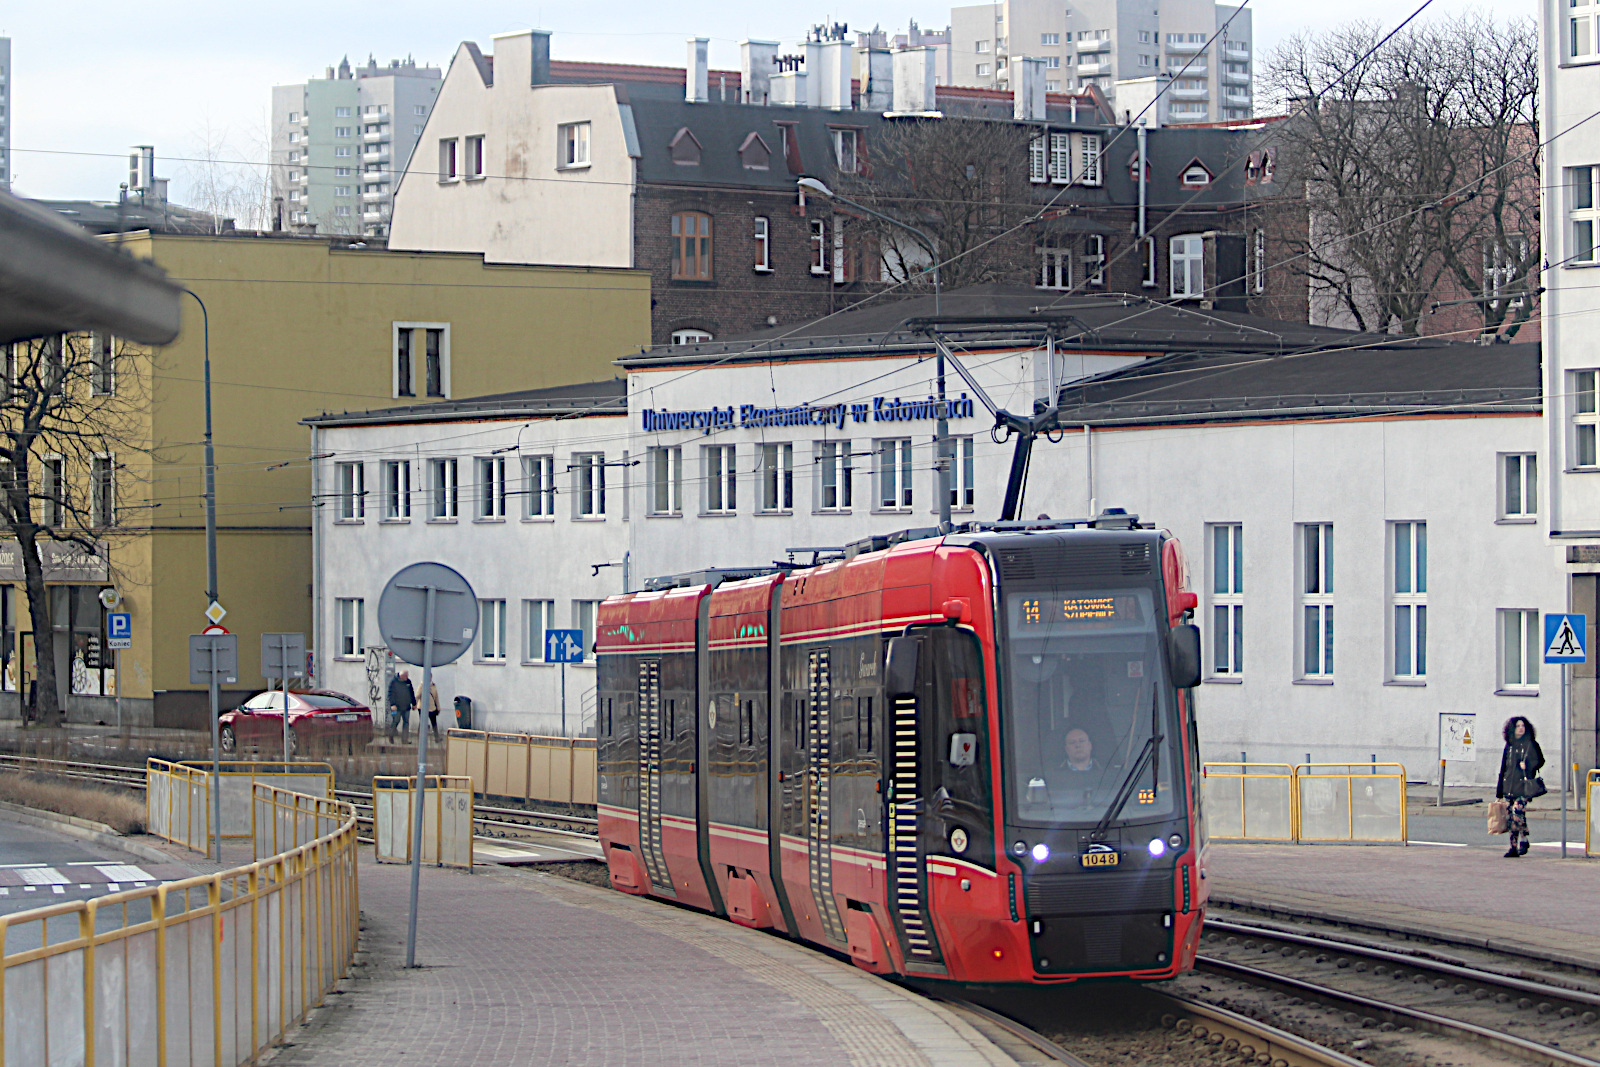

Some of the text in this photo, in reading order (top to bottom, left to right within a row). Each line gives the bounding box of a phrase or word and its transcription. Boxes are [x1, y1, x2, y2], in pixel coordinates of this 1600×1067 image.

[642, 405, 735, 435] Uniwersytet
[739, 402, 848, 430] Ekonomiczny
[850, 402, 869, 424] w
[1022, 600, 1040, 623] 14
[112, 615, 126, 636] P
[1084, 853, 1115, 865] 1048
